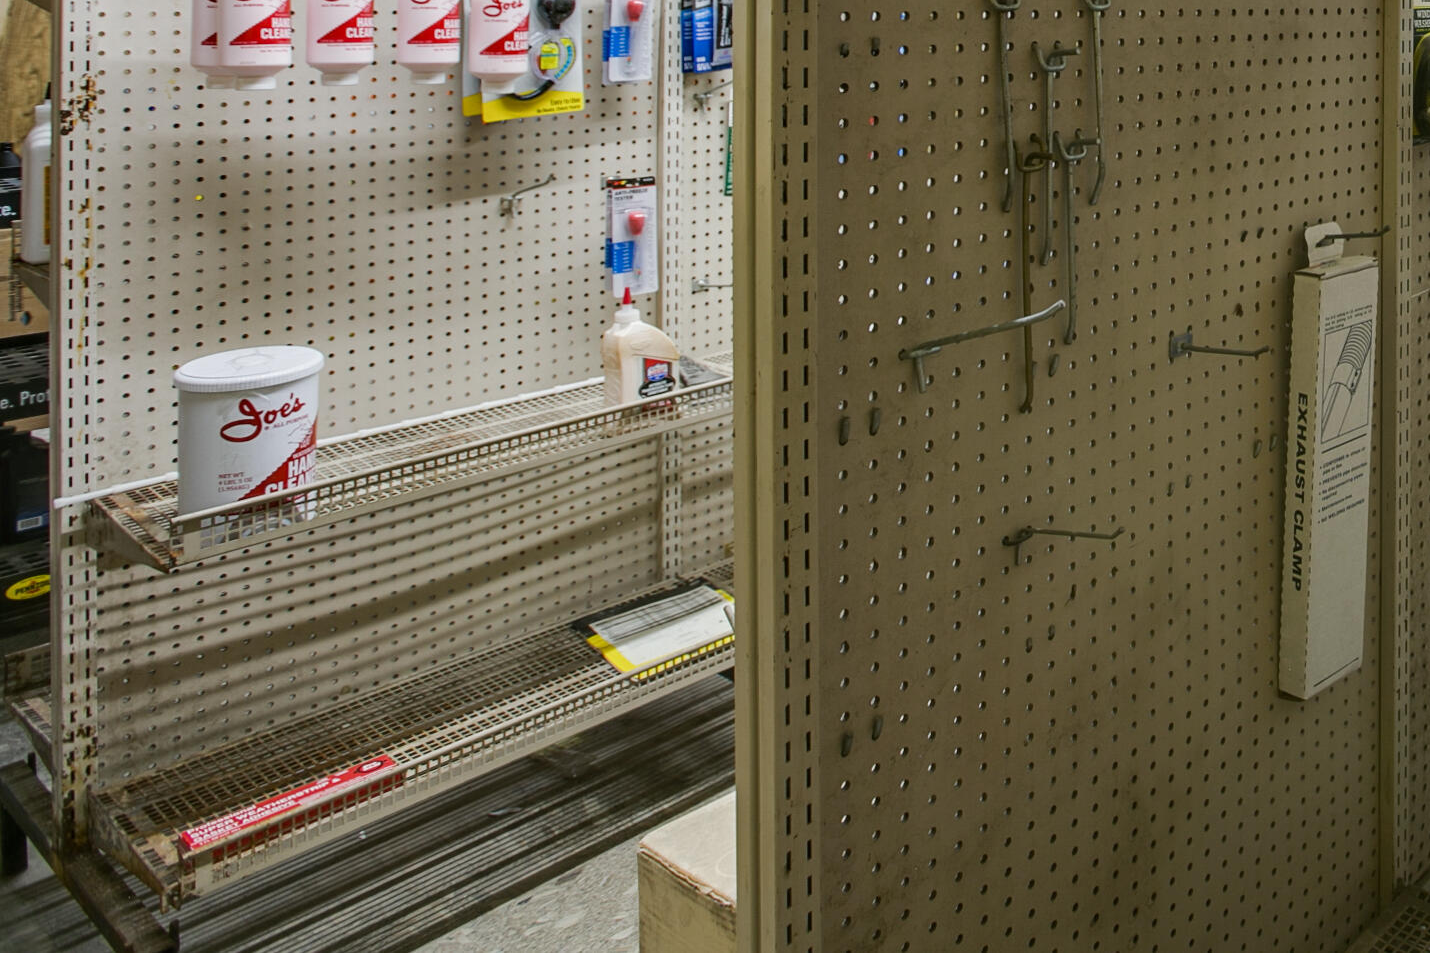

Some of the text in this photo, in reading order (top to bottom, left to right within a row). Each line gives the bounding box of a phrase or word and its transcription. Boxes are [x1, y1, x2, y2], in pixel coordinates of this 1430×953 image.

[220, 392, 306, 443] Joe's
[1292, 392, 1308, 592] EXHAUST CLAMP
[187, 804, 257, 835] Professional
[190, 818, 234, 840] SUPER
[235, 781, 330, 821] WEATHERSTRIP
[192, 822, 240, 844] GASKET
[242, 800, 297, 824] ADHESIVE
